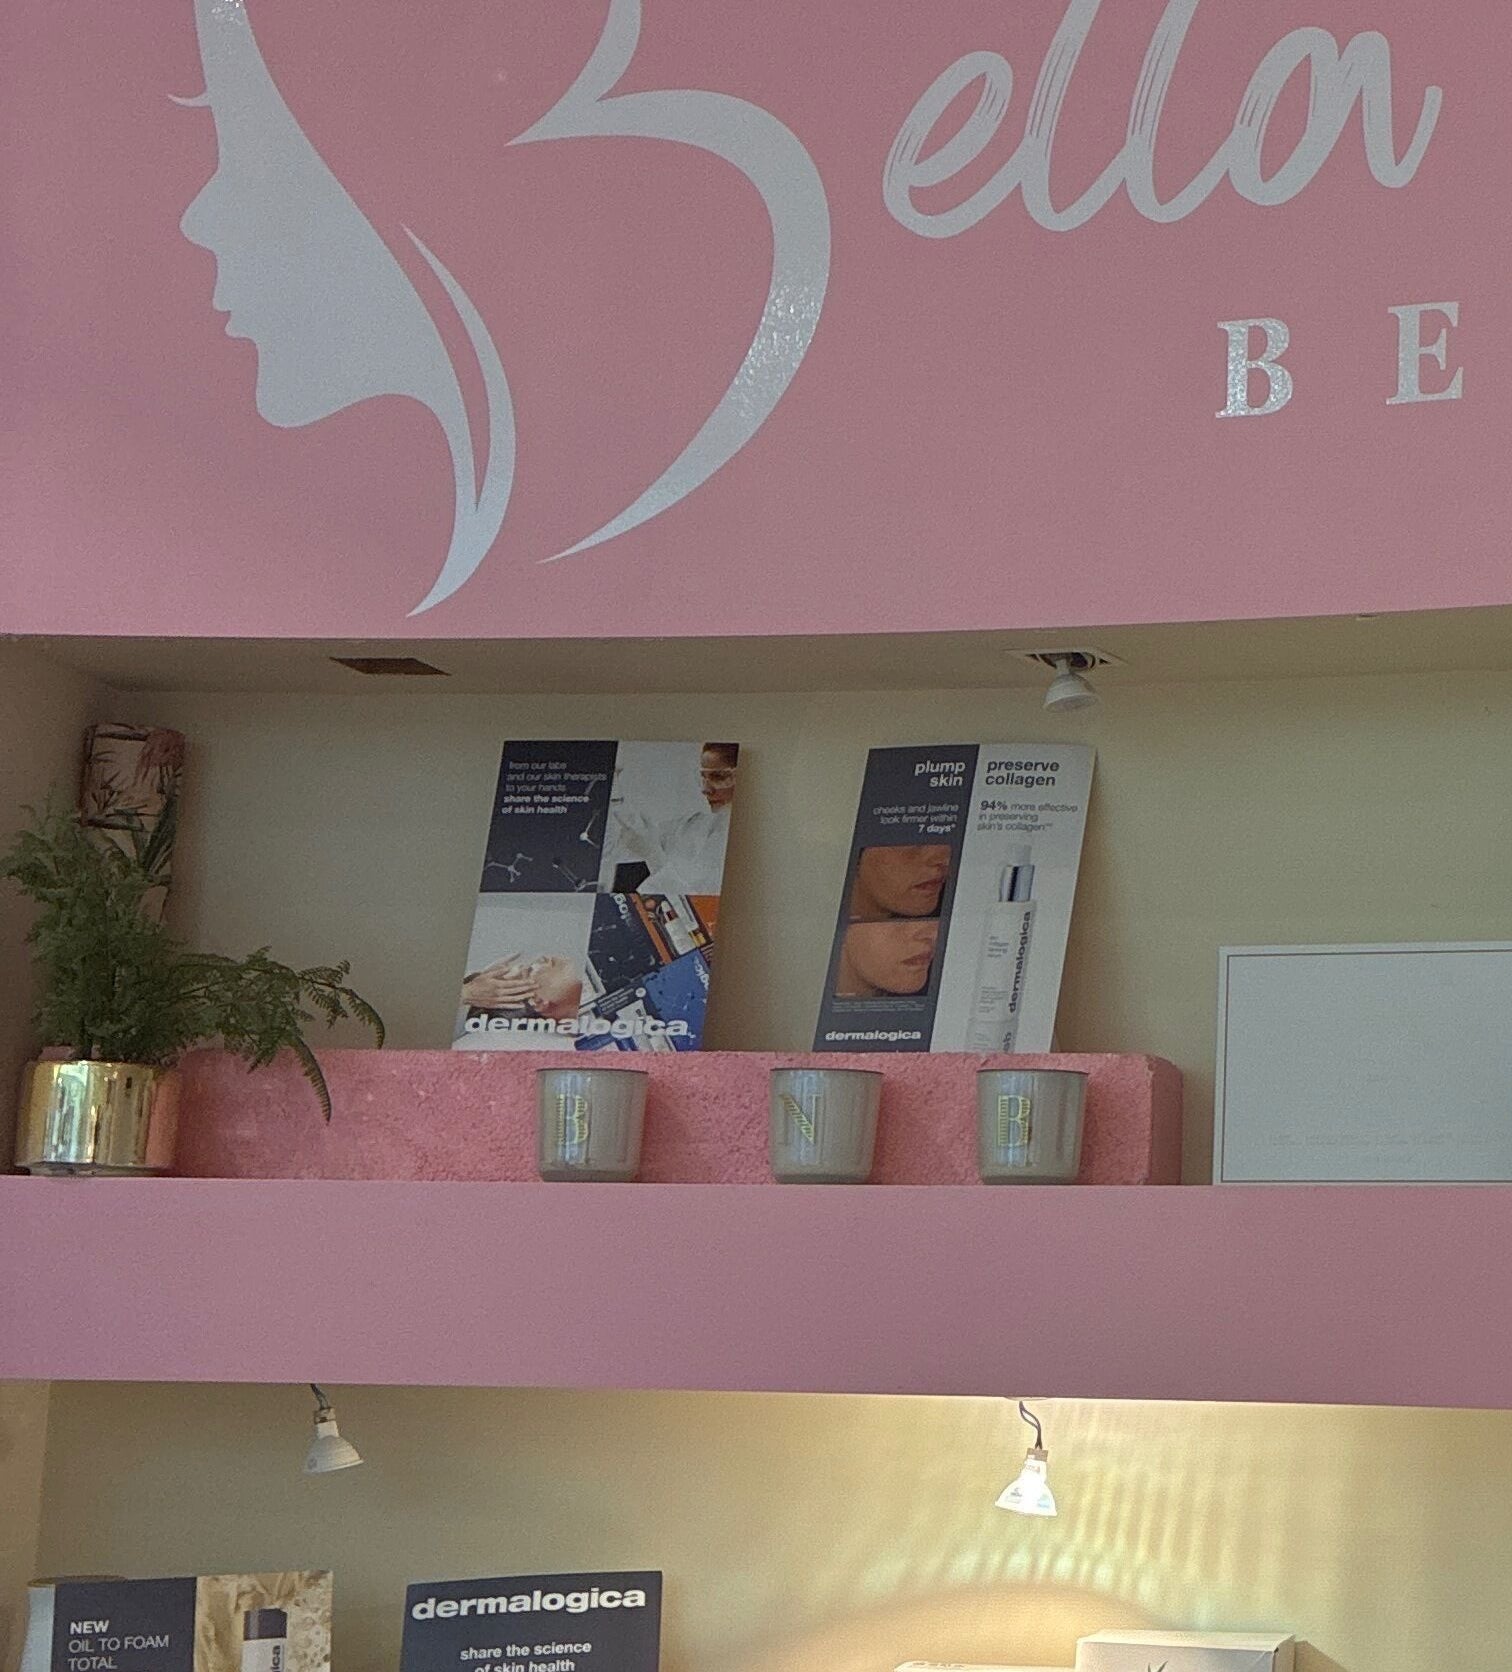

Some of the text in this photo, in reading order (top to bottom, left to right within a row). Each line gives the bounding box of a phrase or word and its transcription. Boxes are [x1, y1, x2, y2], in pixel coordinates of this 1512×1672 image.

[914, 760, 966, 777] plump
[986, 760, 1060, 774] preserve
[929, 773, 964, 788] skin
[985, 772, 1056, 789] collagen
[503, 794, 589, 803] share the science
[980, 800, 1008, 811] 94%
[1010, 803, 1036, 811] more
[501, 805, 568, 814] of skin health
[918, 824, 926, 833] 7
[1008, 911, 1031, 1014] dermalogica
[463, 1013, 690, 1039] dermalogica
[825, 1029, 922, 1042] dermalogica
[411, 1587, 647, 1621] dermalogica
[69, 1620, 109, 1635] NEW
[68, 1635, 170, 1654] OIL TO FOAM
[460, 1641, 592, 1661] share the science
[68, 1655, 118, 1672] TOTAL
[474, 1658, 576, 1672] of skin health
